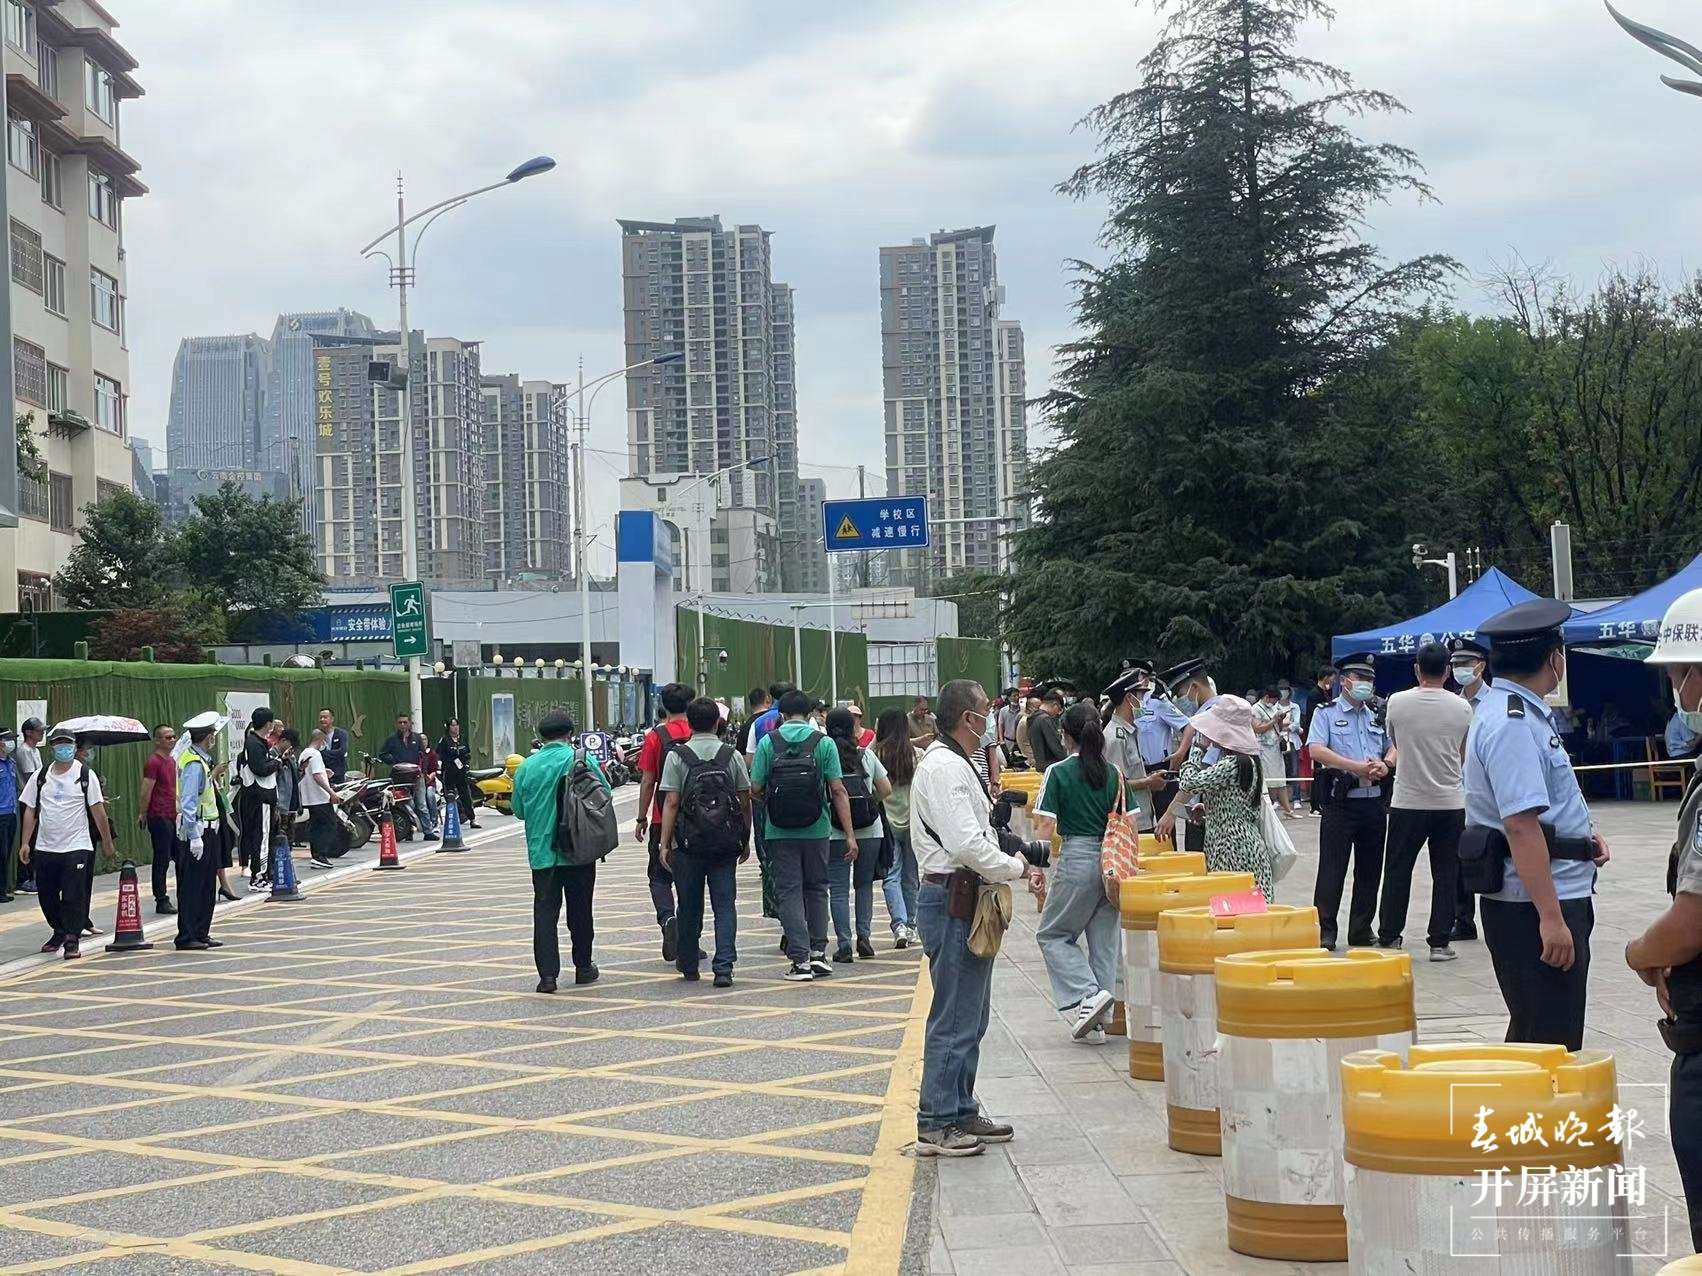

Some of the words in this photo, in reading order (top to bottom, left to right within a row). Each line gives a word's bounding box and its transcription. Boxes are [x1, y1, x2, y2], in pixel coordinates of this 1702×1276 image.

[317, 356, 334, 438] 壹号欢乐城
[879, 508, 916, 521] 学校区
[871, 525, 920, 539] 减速慢行
[347, 616, 393, 632] 安全带体验
[1598, 621, 1638, 640] 五华
[1659, 623, 1702, 643] 中保联
[1380, 634, 1416, 654] 五华
